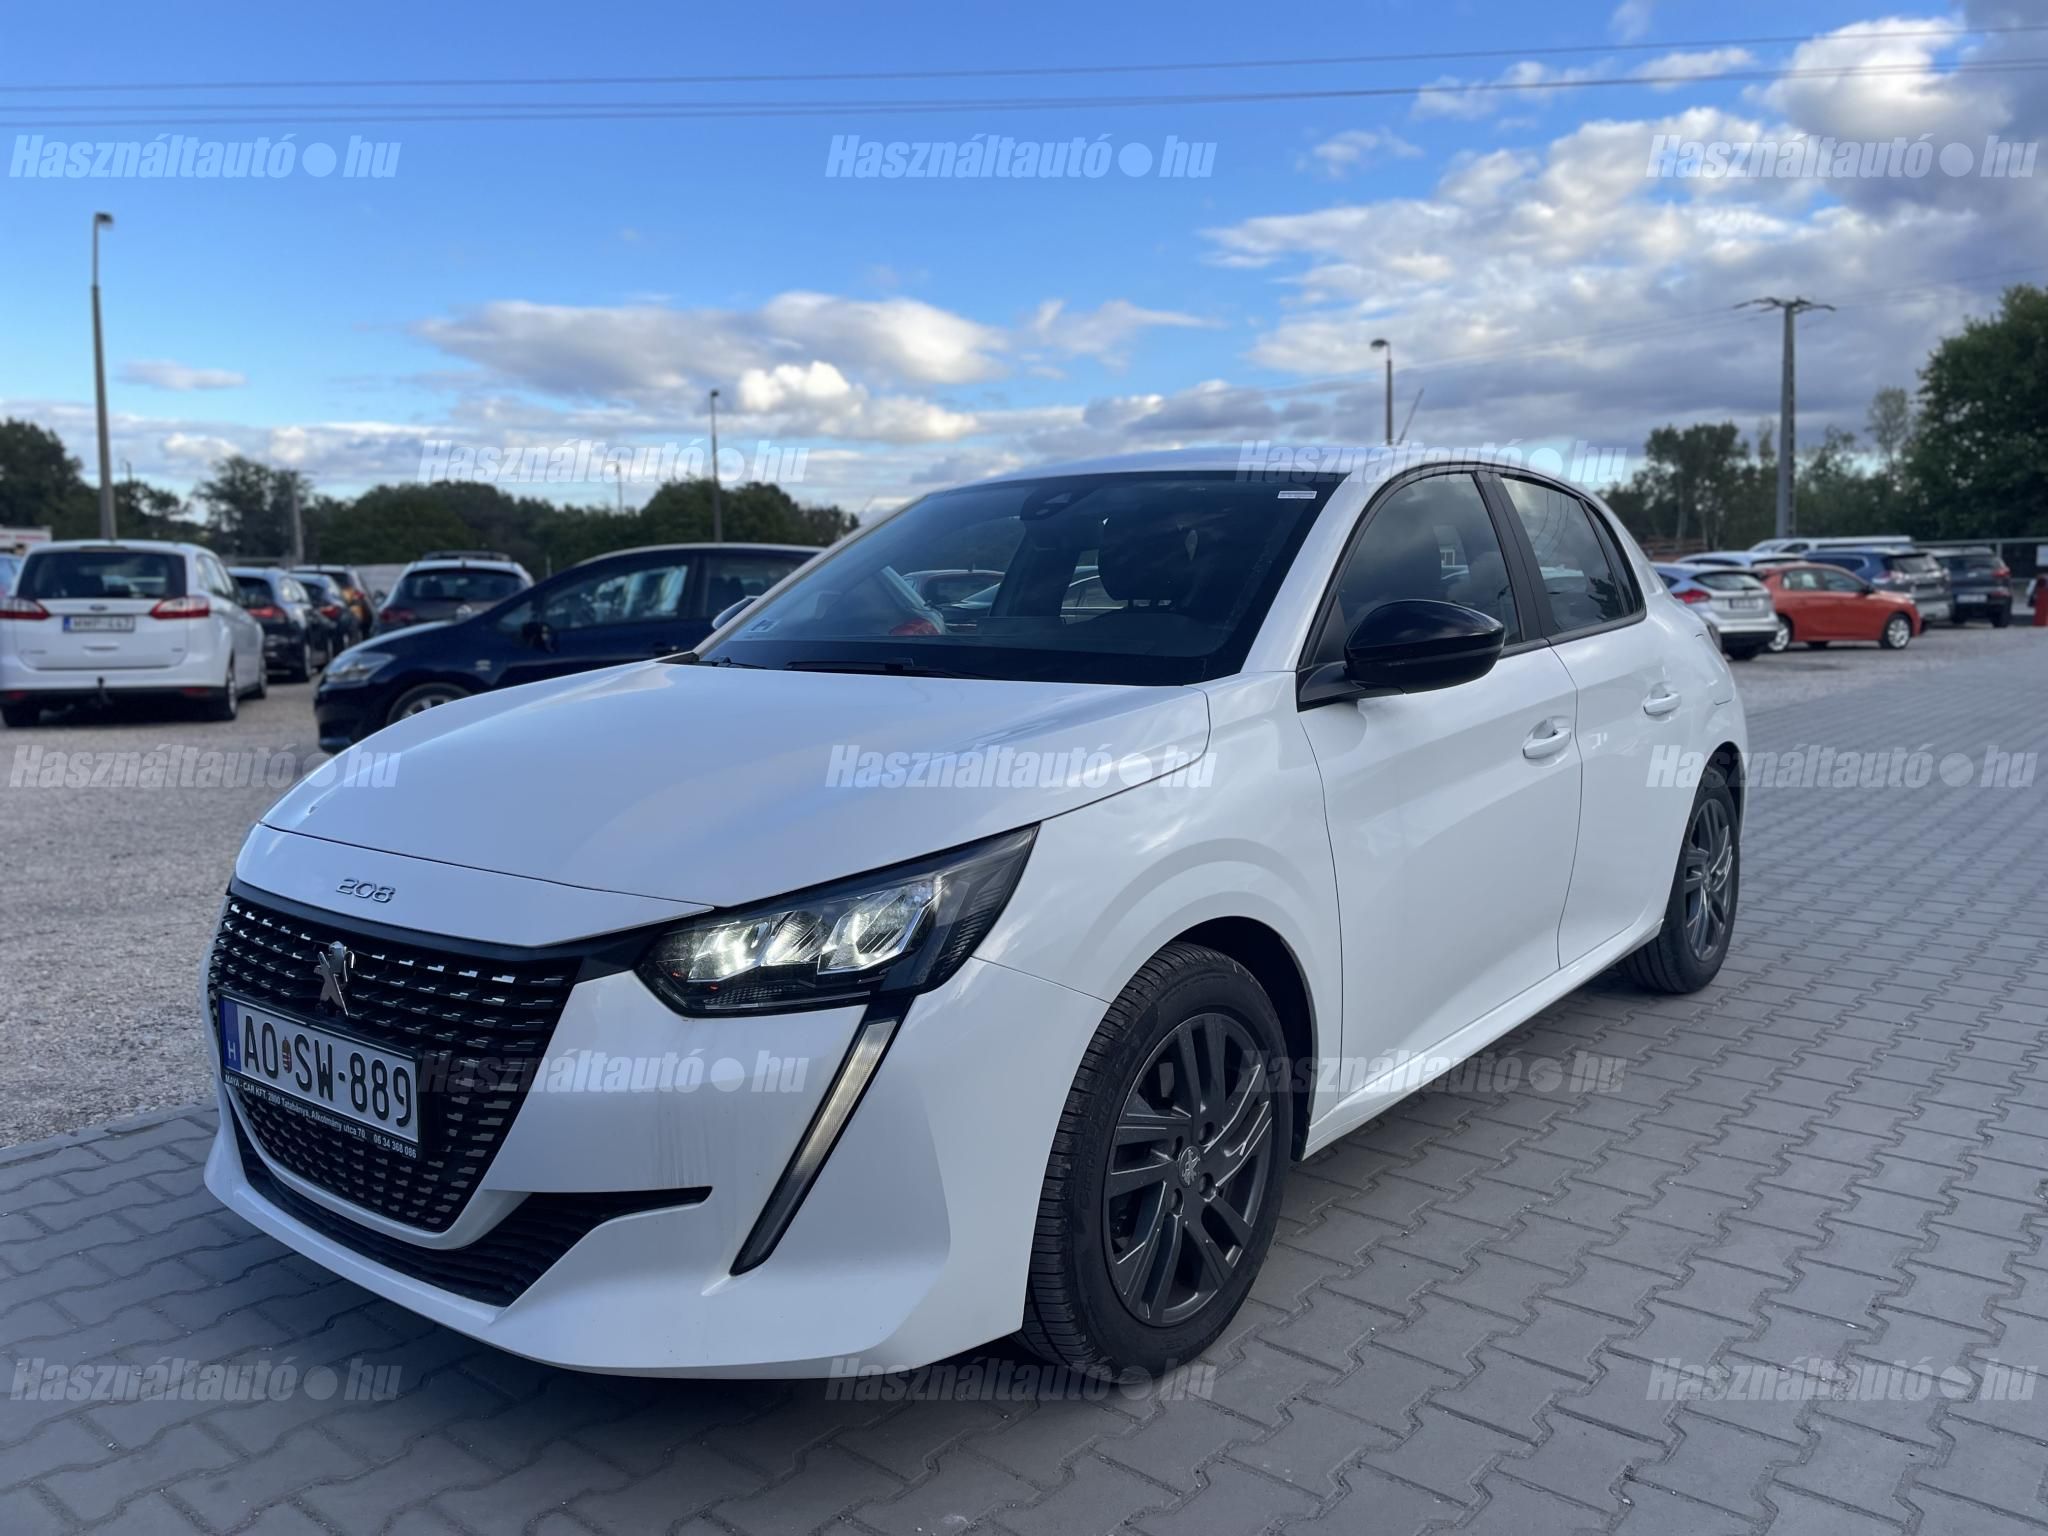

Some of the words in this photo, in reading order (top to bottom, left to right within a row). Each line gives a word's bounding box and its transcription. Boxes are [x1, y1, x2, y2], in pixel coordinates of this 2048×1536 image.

[336, 878, 396, 904] 208
[227, 1040, 237, 1061] H
[243, 1082, 254, 1095] CAR
[382, 1137, 391, 1148] 34
